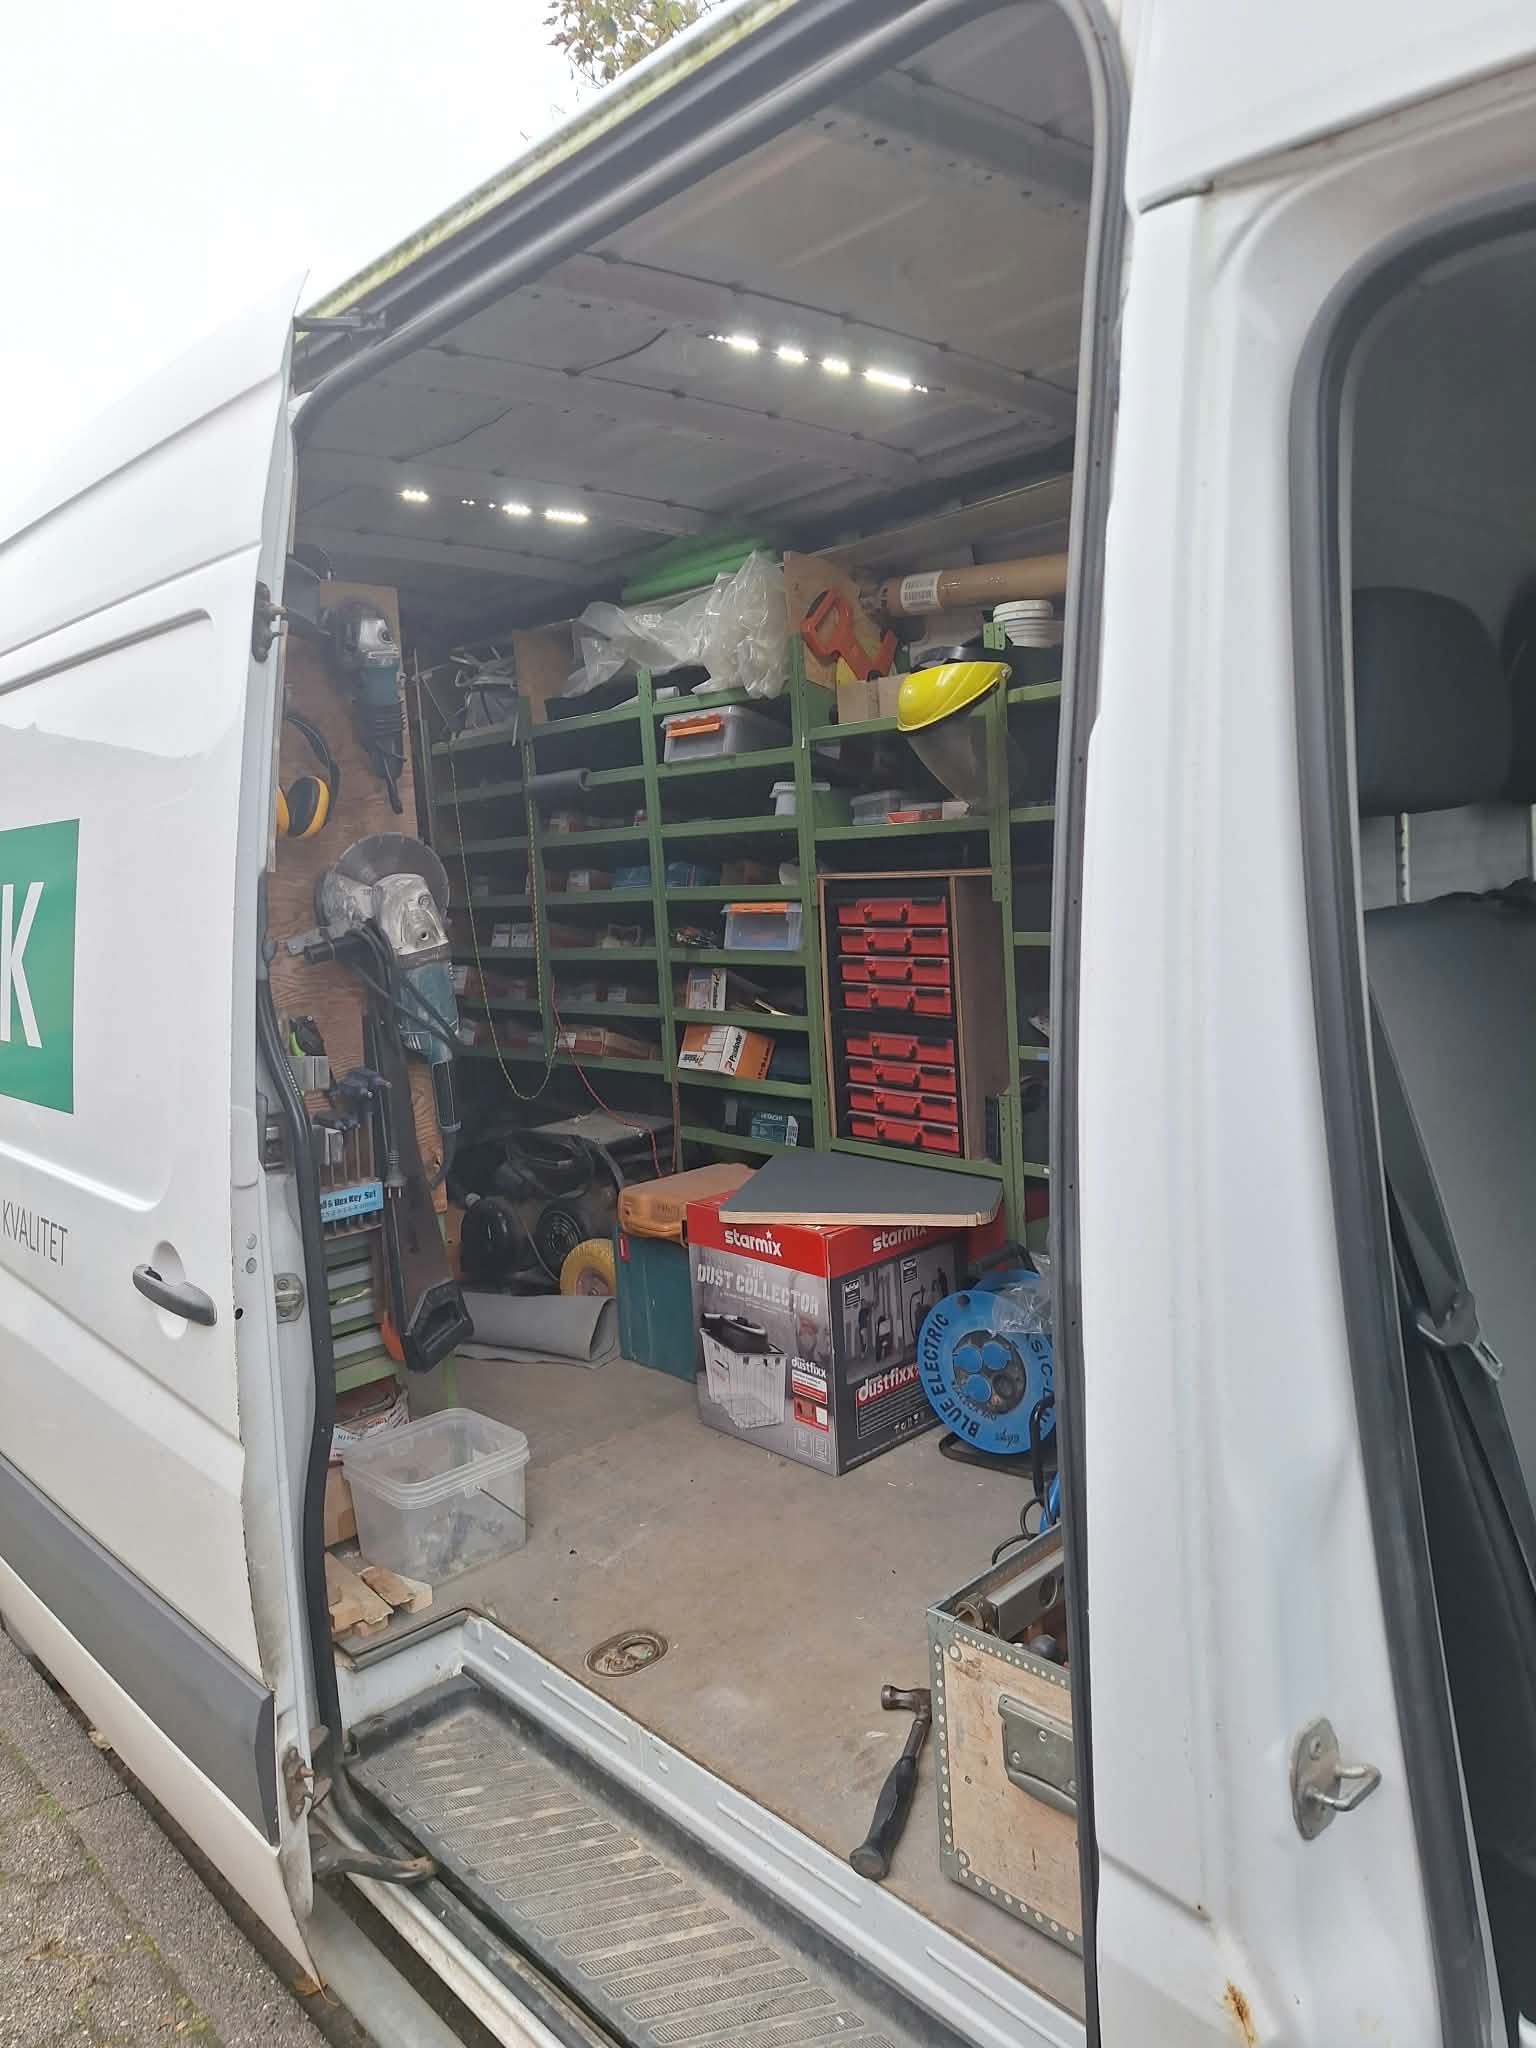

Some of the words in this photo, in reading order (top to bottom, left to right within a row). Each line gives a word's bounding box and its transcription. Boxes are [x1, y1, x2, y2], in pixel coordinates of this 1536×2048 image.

[0, 882, 45, 1048] K
[364, 1189, 377, 1199] Set
[2, 1199, 68, 1267] KVALITET
[724, 1228, 783, 1257] starmix
[872, 1225, 928, 1253] starmix
[697, 1263, 734, 1290] DUST
[791, 1356, 827, 1379] dustfixx
[923, 1313, 950, 1397] ELECTRIC
[858, 1364, 915, 1402] dustfixx
[939, 1398, 981, 1438] BLUE
